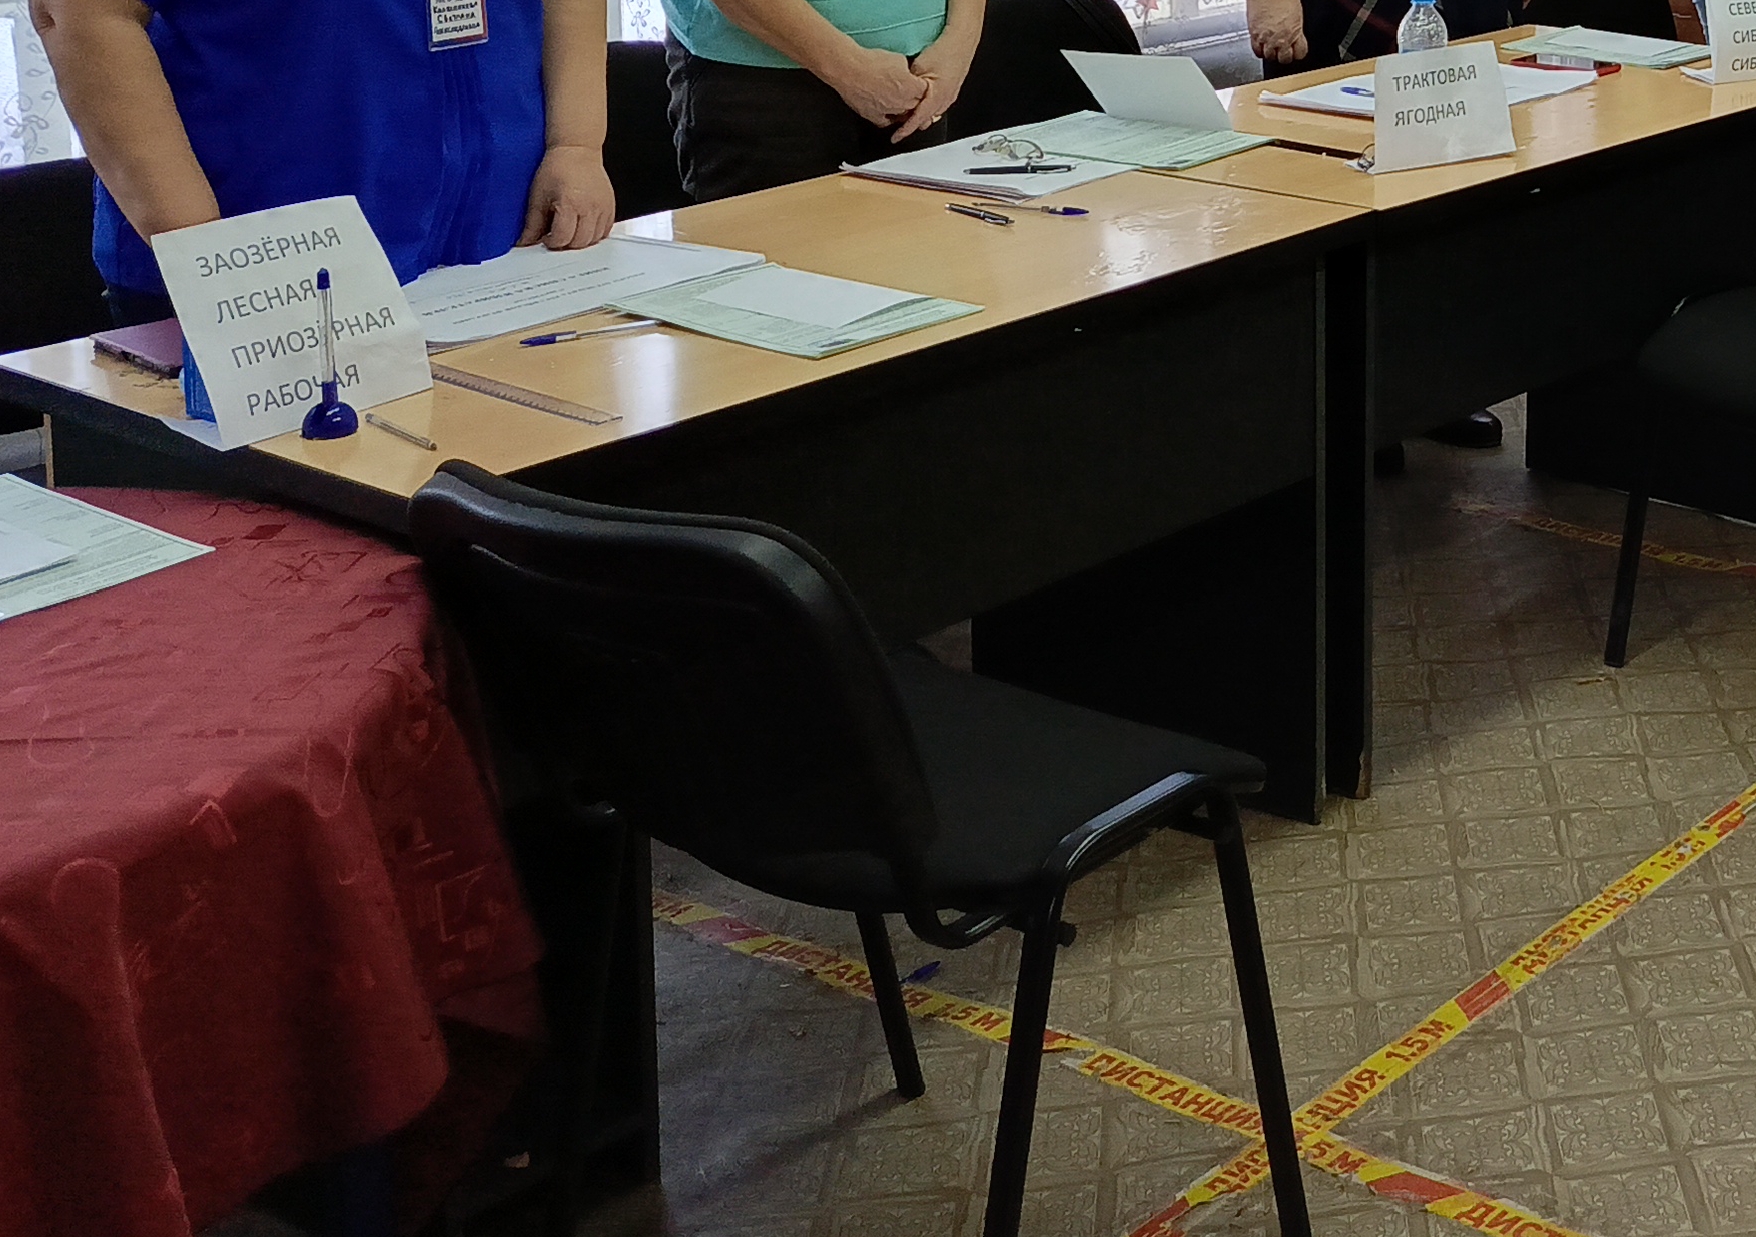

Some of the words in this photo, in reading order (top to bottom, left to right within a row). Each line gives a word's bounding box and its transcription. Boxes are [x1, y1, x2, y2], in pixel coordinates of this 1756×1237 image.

[1391, 63, 1477, 92] ТРАКТОВАЯ
[1393, 100, 1466, 127] ЯГОДНАЯ
[195, 226, 342, 278] ЗАОЗЁРНАЯ
[217, 278, 317, 324] ЛЕСНАЯ
[231, 306, 396, 369] ПРИОЗРНАЯ
[751, 939, 934, 1010] ДИСТАНЯ
